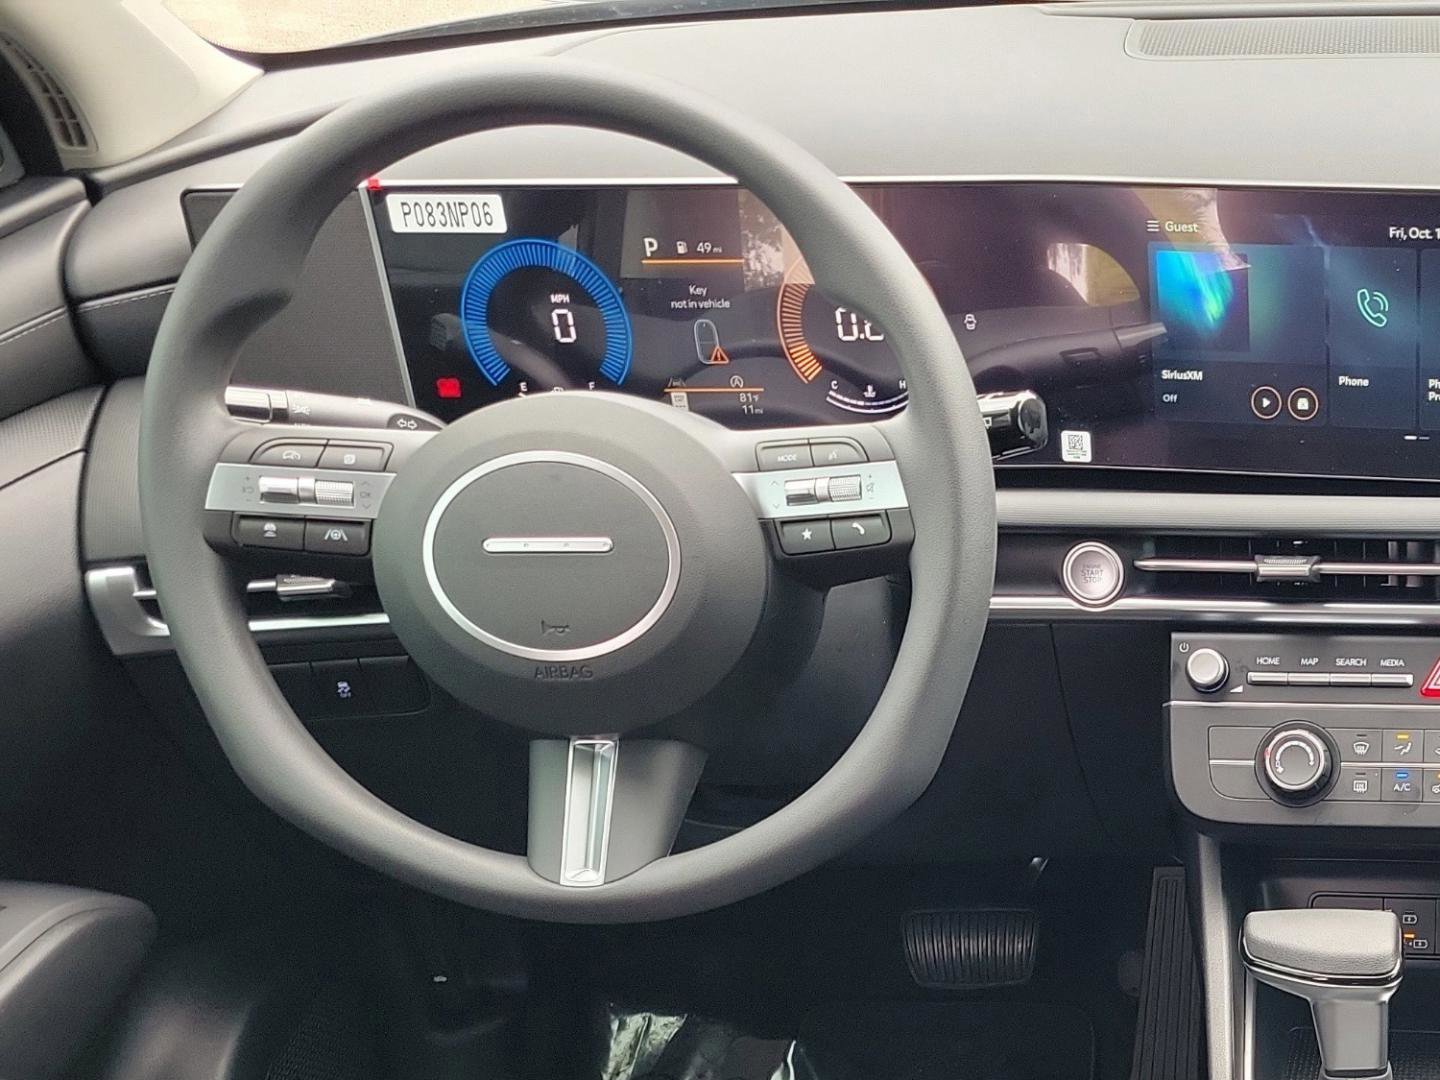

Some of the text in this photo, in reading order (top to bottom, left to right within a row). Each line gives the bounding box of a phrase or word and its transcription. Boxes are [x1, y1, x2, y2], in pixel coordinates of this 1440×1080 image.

[401, 202, 493, 227] P083NP06
[1165, 221, 1199, 232] Guest
[1389, 227, 1407, 240] Fri,
[643, 237, 658, 257] P
[696, 242, 712, 253] 49
[689, 285, 707, 297] Key
[551, 294, 570, 303] MPH
[671, 299, 731, 309] not in vehicle
[552, 309, 577, 343] 0
[1161, 370, 1203, 380] SiriusXM
[520, 381, 528, 391] E
[831, 380, 839, 390] C
[1338, 376, 1369, 387] Phone
[1163, 394, 1178, 403] Off
[777, 454, 797, 462] MODE
[1256, 656, 1281, 665] HOME
[1300, 657, 1319, 666] MAP
[1335, 658, 1367, 667] SEARCH
[1380, 659, 1405, 667] MEDIA
[534, 665, 593, 679] AIRBAG
[1393, 783, 1411, 792] A/C
